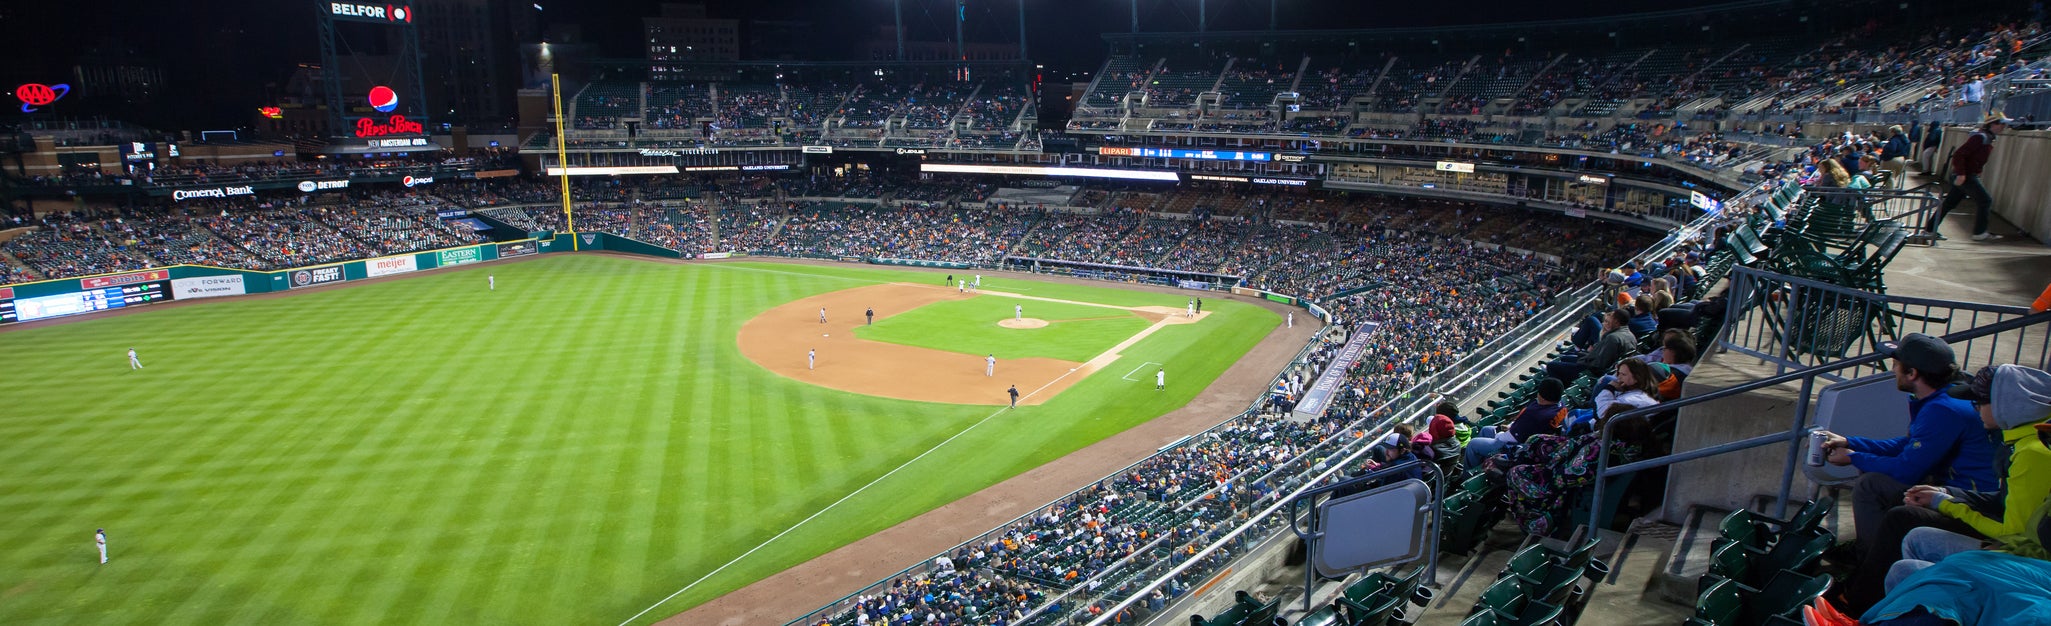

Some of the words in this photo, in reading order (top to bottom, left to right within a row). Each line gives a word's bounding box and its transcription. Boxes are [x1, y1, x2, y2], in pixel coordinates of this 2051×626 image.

[331, 2, 385, 18] BELFOR
[20, 84, 53, 105] AAA
[356, 117, 387, 138] PEPSI
[388, 114, 422, 134] PORCH
[367, 140, 380, 149] NEW
[380, 139, 411, 148] AMSTERDAM
[318, 180, 350, 190] DETROIT
[415, 176, 433, 185] pepsi
[226, 185, 254, 196] Bank
[441, 249, 476, 259] EASTERN
[377, 257, 406, 271] meijer
[312, 267, 339, 275] FREAKY
[110, 275, 146, 285] bitbits
[202, 277, 243, 286] FORWARD
[313, 272, 339, 283] FAST!
[1315, 376, 1337, 391] HOME
[1334, 360, 1349, 369] THE
